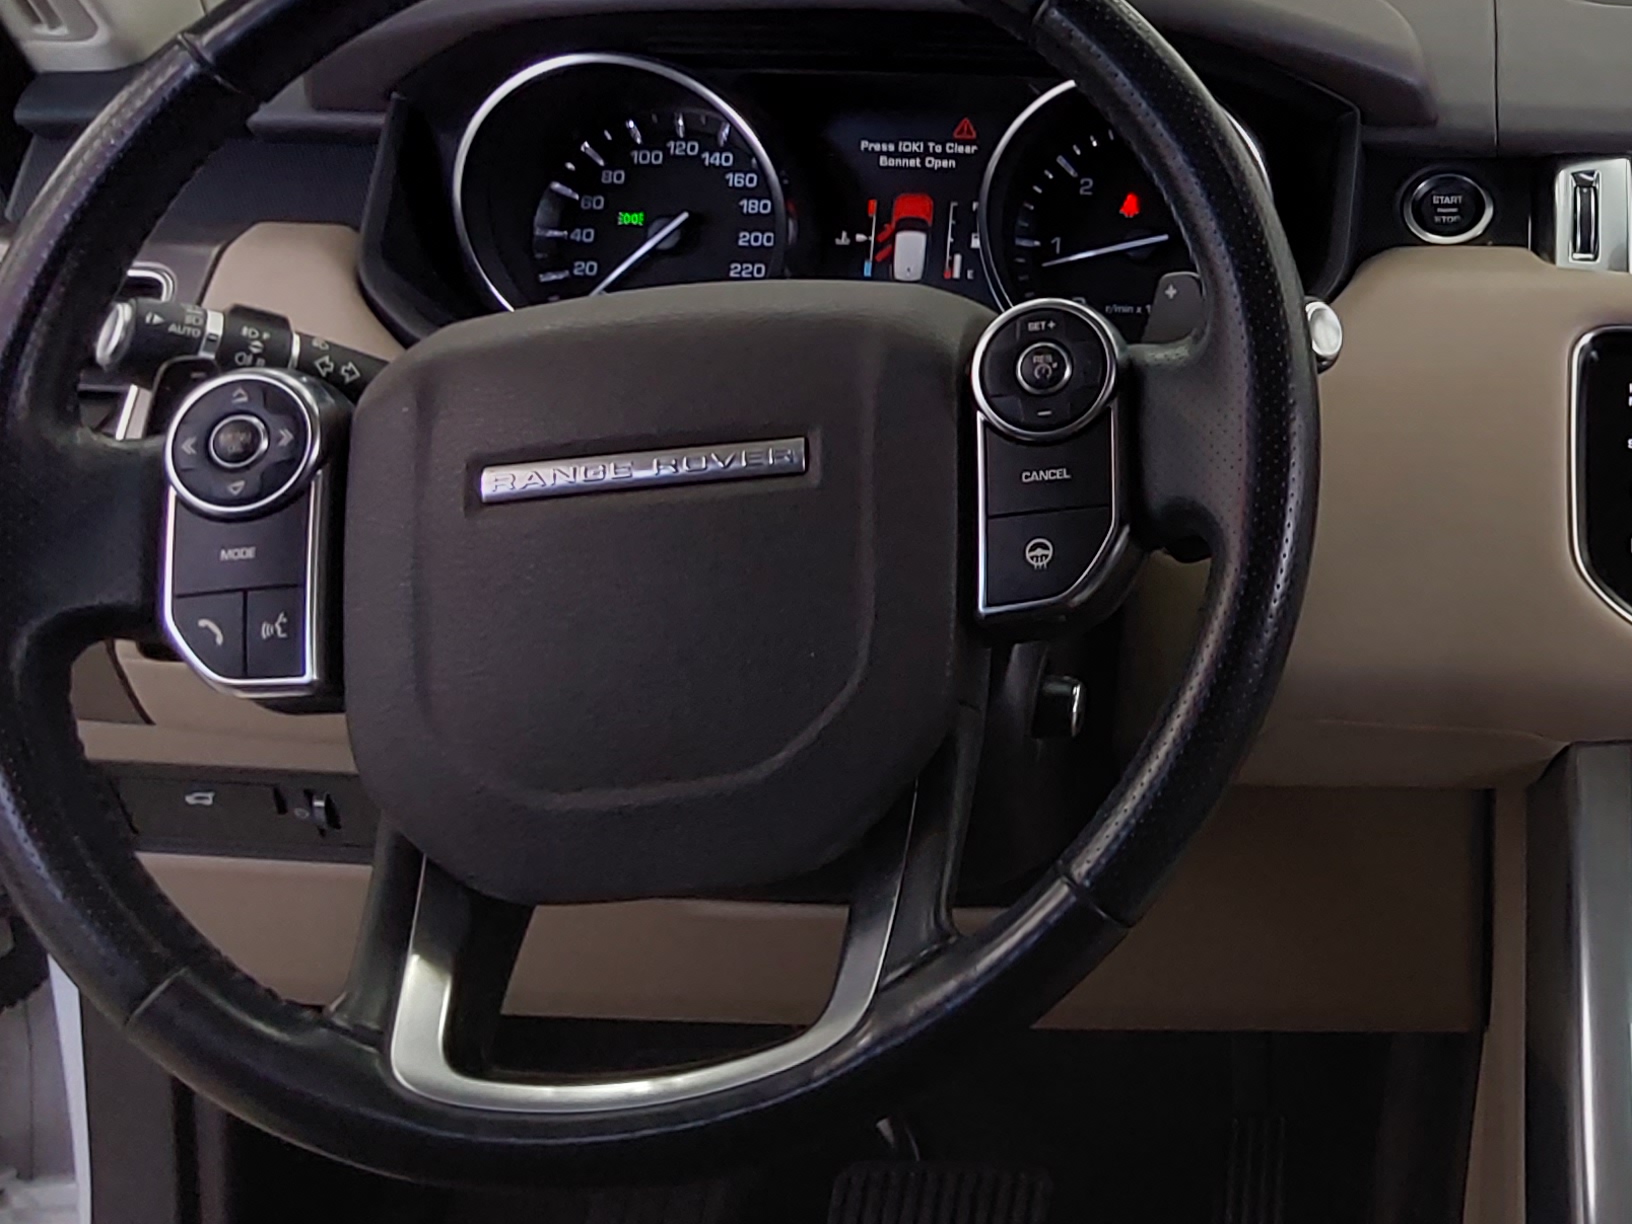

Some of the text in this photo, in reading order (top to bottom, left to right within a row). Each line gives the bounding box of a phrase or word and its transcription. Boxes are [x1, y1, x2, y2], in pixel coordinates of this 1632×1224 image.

[666, 140, 699, 156] 120
[860, 140, 896, 153] Press
[927, 141, 943, 153] To
[945, 141, 978, 154] Clear
[630, 150, 663, 165] 100
[701, 151, 734, 167] 140
[879, 155, 956, 170] Bonnet Open
[601, 169, 625, 184] 80
[725, 172, 758, 188] 160
[1079, 178, 1094, 195] 2
[580, 195, 605, 210] 60
[739, 199, 772, 214] 180
[1433, 195, 1463, 204] START
[570, 228, 595, 243] 40
[738, 232, 774, 247] 200
[1050, 236, 1062, 254] 1
[573, 261, 598, 276] 20
[729, 263, 766, 278] 220
[167, 323, 202, 338] AUTO
[491, 446, 797, 494] RANGE ROVER
[1021, 467, 1072, 484] CANCEL
[219, 546, 257, 562] MODE
